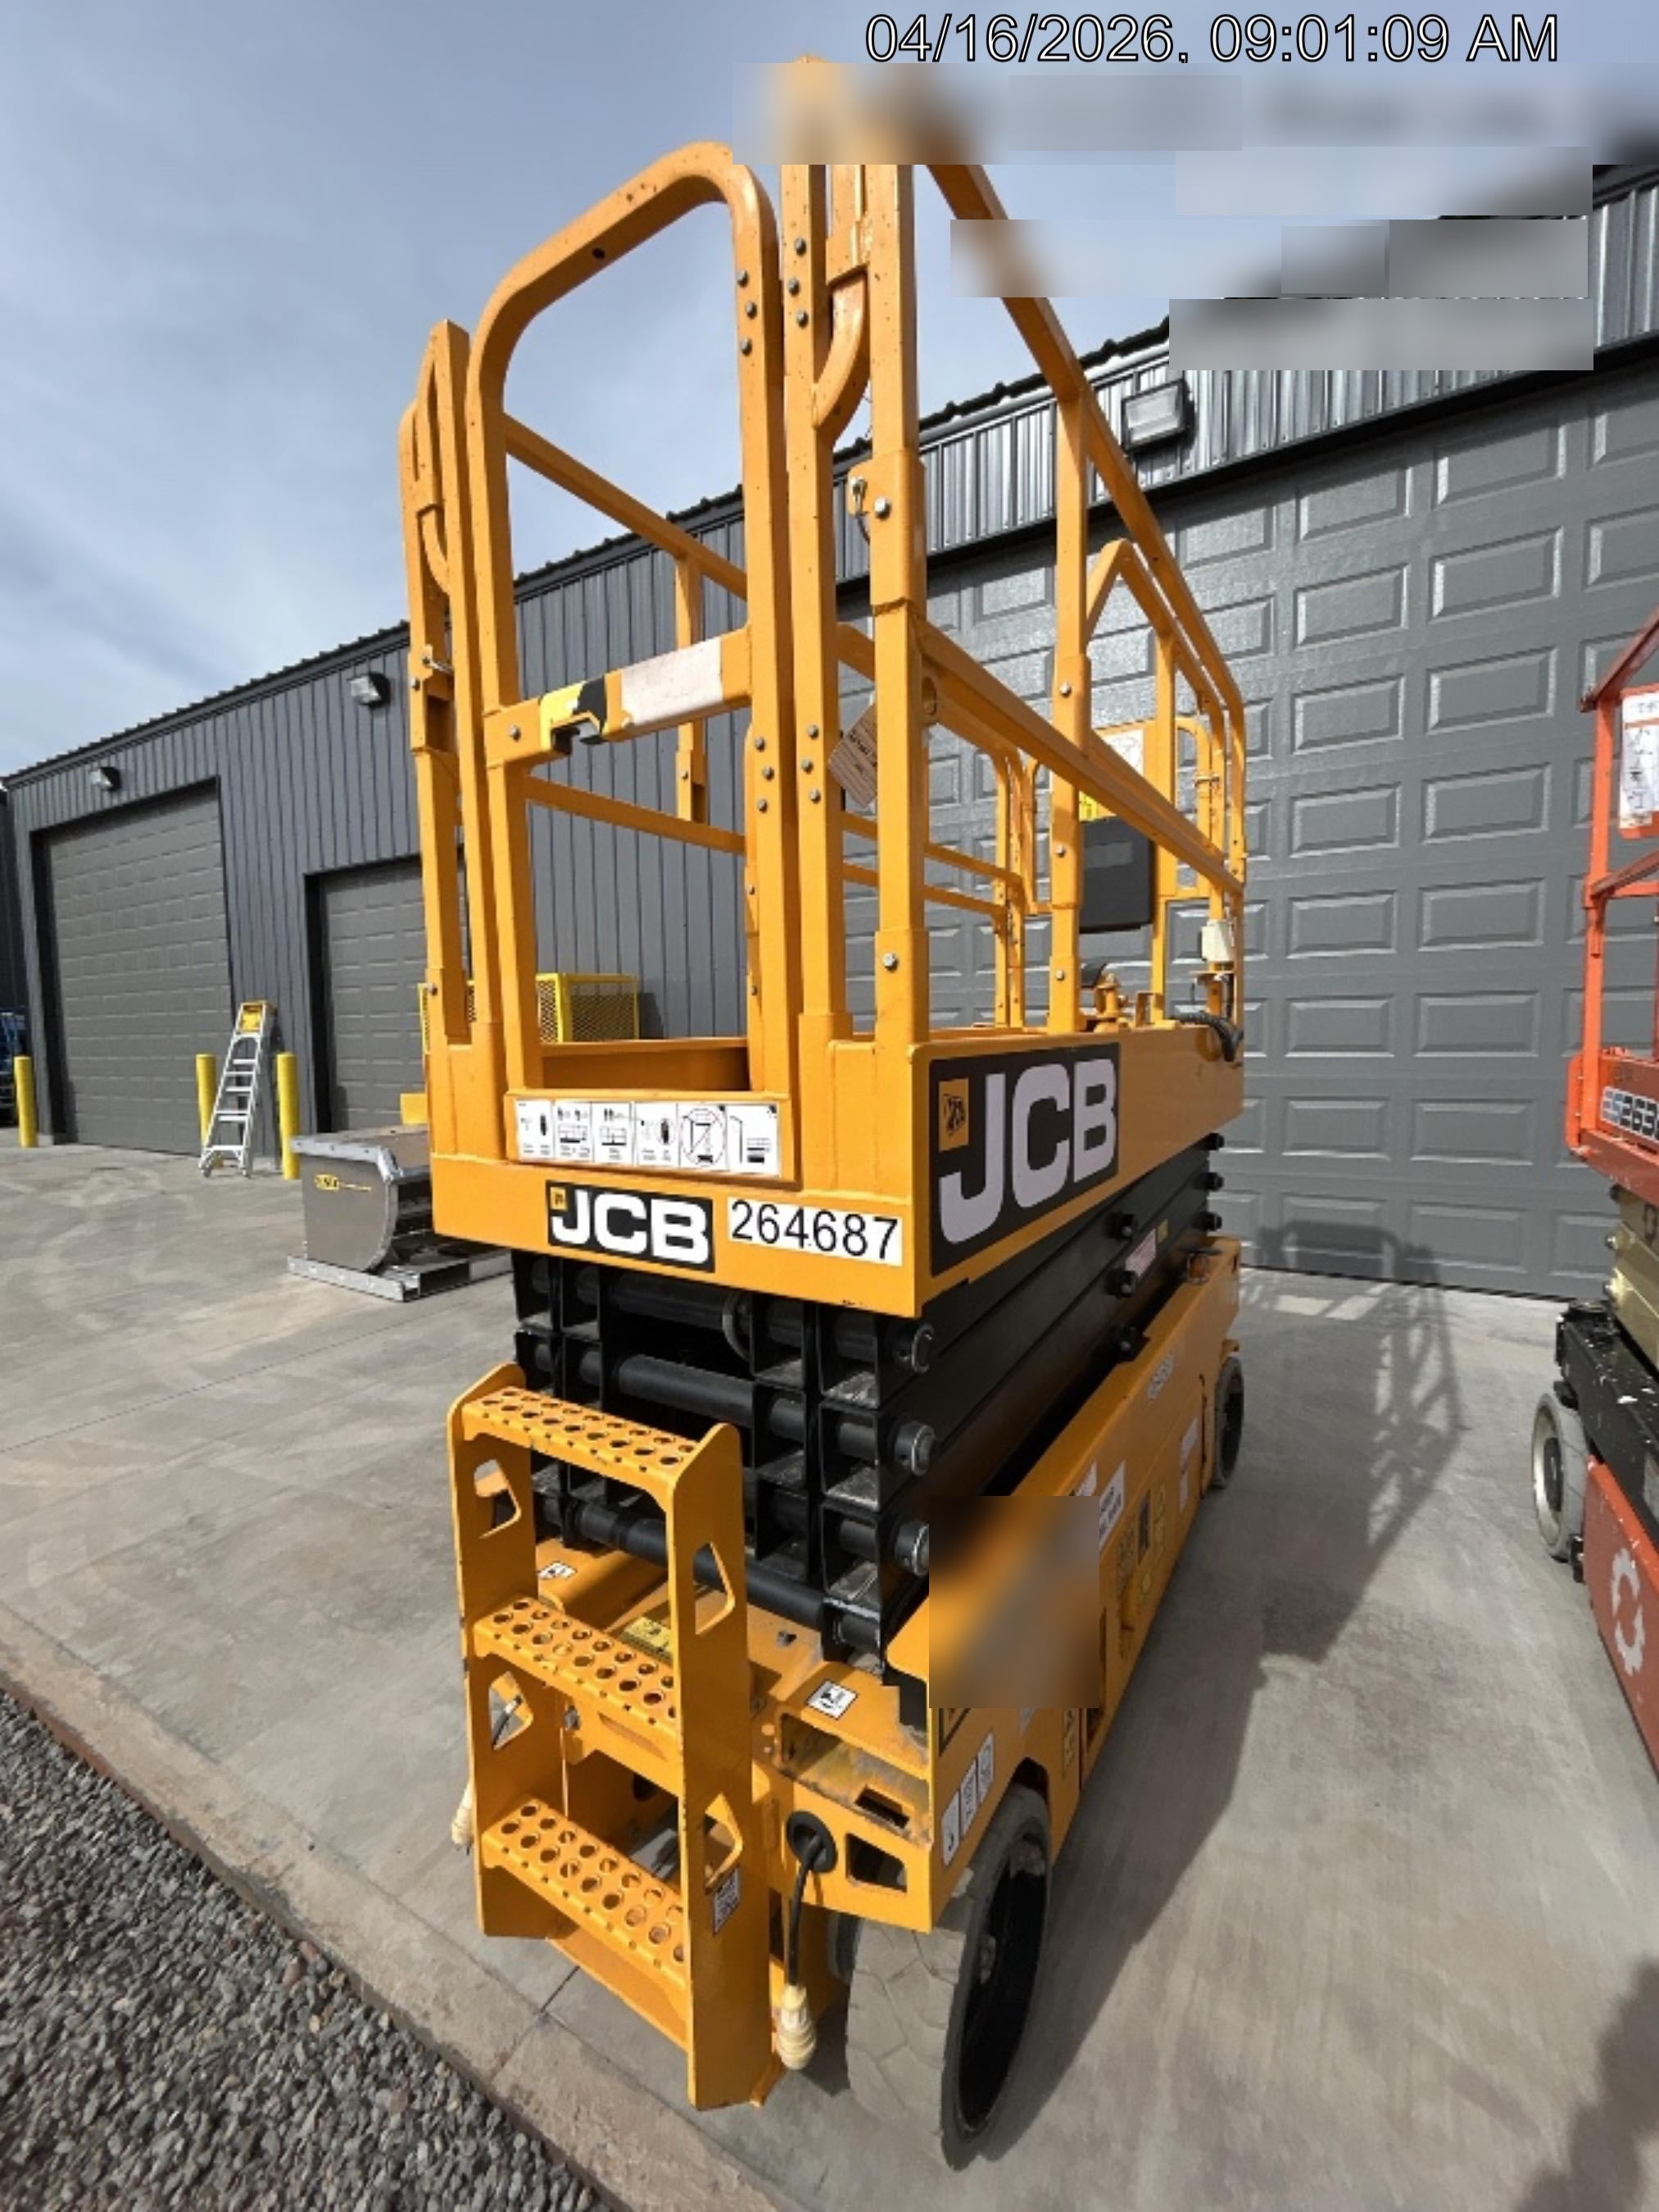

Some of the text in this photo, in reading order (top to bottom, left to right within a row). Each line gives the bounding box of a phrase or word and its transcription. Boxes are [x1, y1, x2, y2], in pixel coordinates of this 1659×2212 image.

[939, 1058, 1117, 1244] JCB
[551, 1188, 709, 1265] JCB
[731, 1199, 899, 1260] 264687
